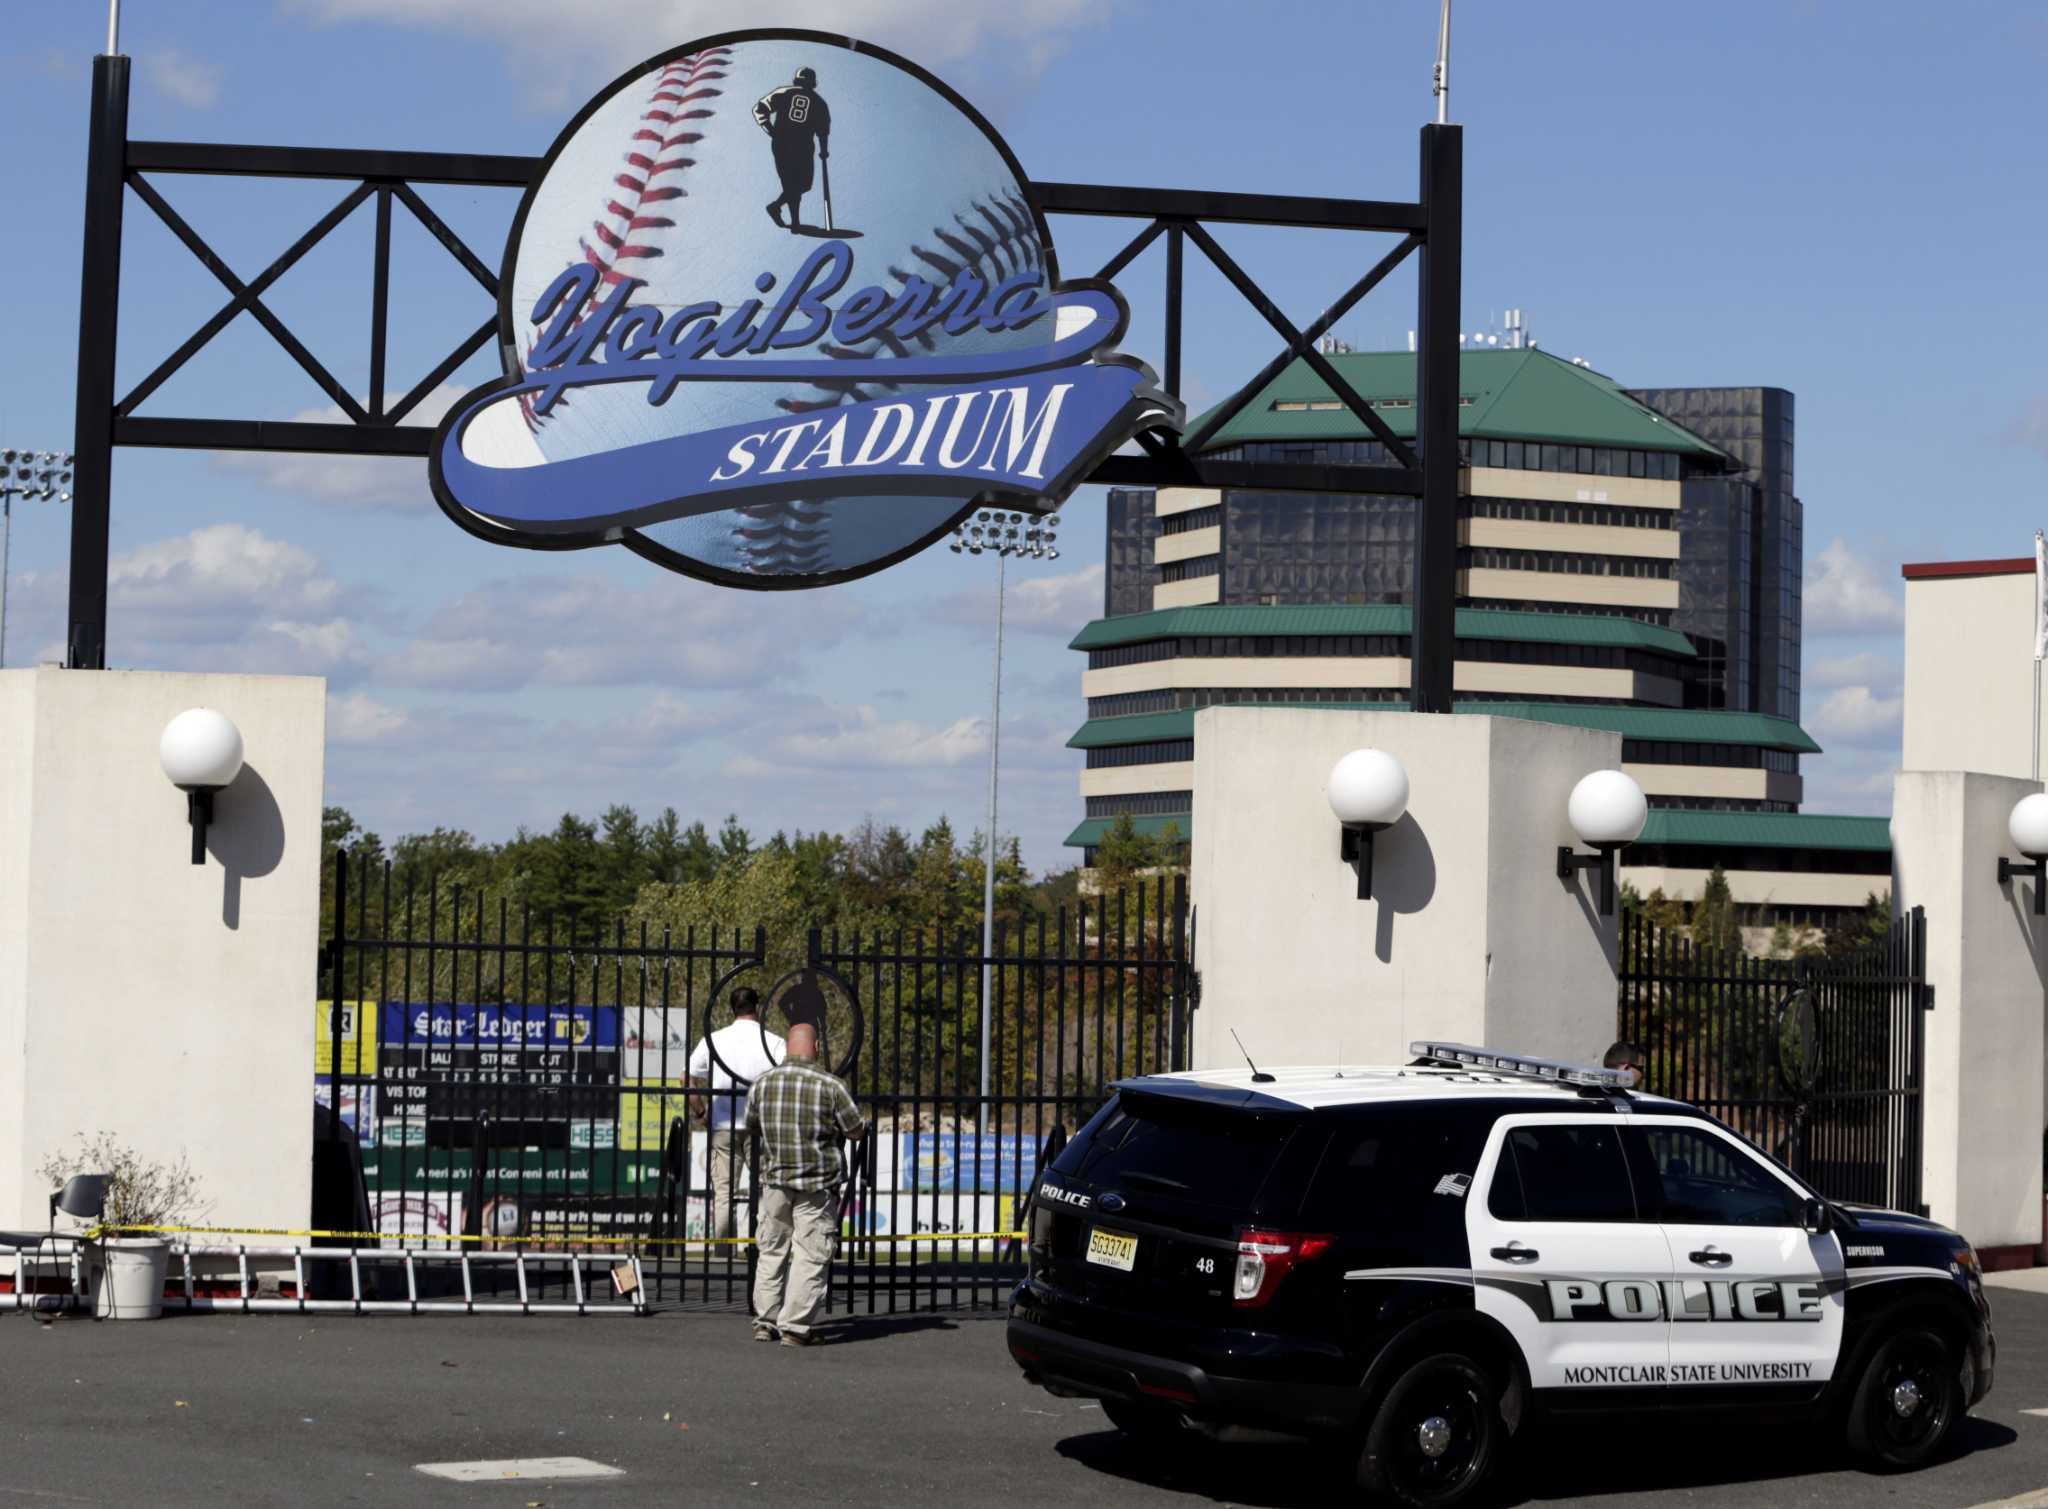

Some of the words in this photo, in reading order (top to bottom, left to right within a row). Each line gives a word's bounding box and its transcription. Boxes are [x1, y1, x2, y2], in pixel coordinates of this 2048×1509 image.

[788, 93, 811, 124] 8
[528, 261, 780, 414] Yogi
[750, 240, 1056, 357] Berra
[708, 383, 1075, 485] STADIUM
[386, 1085, 428, 1098] VISTOR
[1040, 1183, 1091, 1207] POLICE
[1846, 1246, 1885, 1257] SUPERVISOR
[1196, 1257, 1215, 1274] 48
[1544, 1279, 1824, 1322] POLICE
[1563, 1365, 1667, 1384] MONTCLAIR
[1670, 1364, 1717, 1382] STATE
[1720, 1362, 1813, 1381] UNIVERSITY
